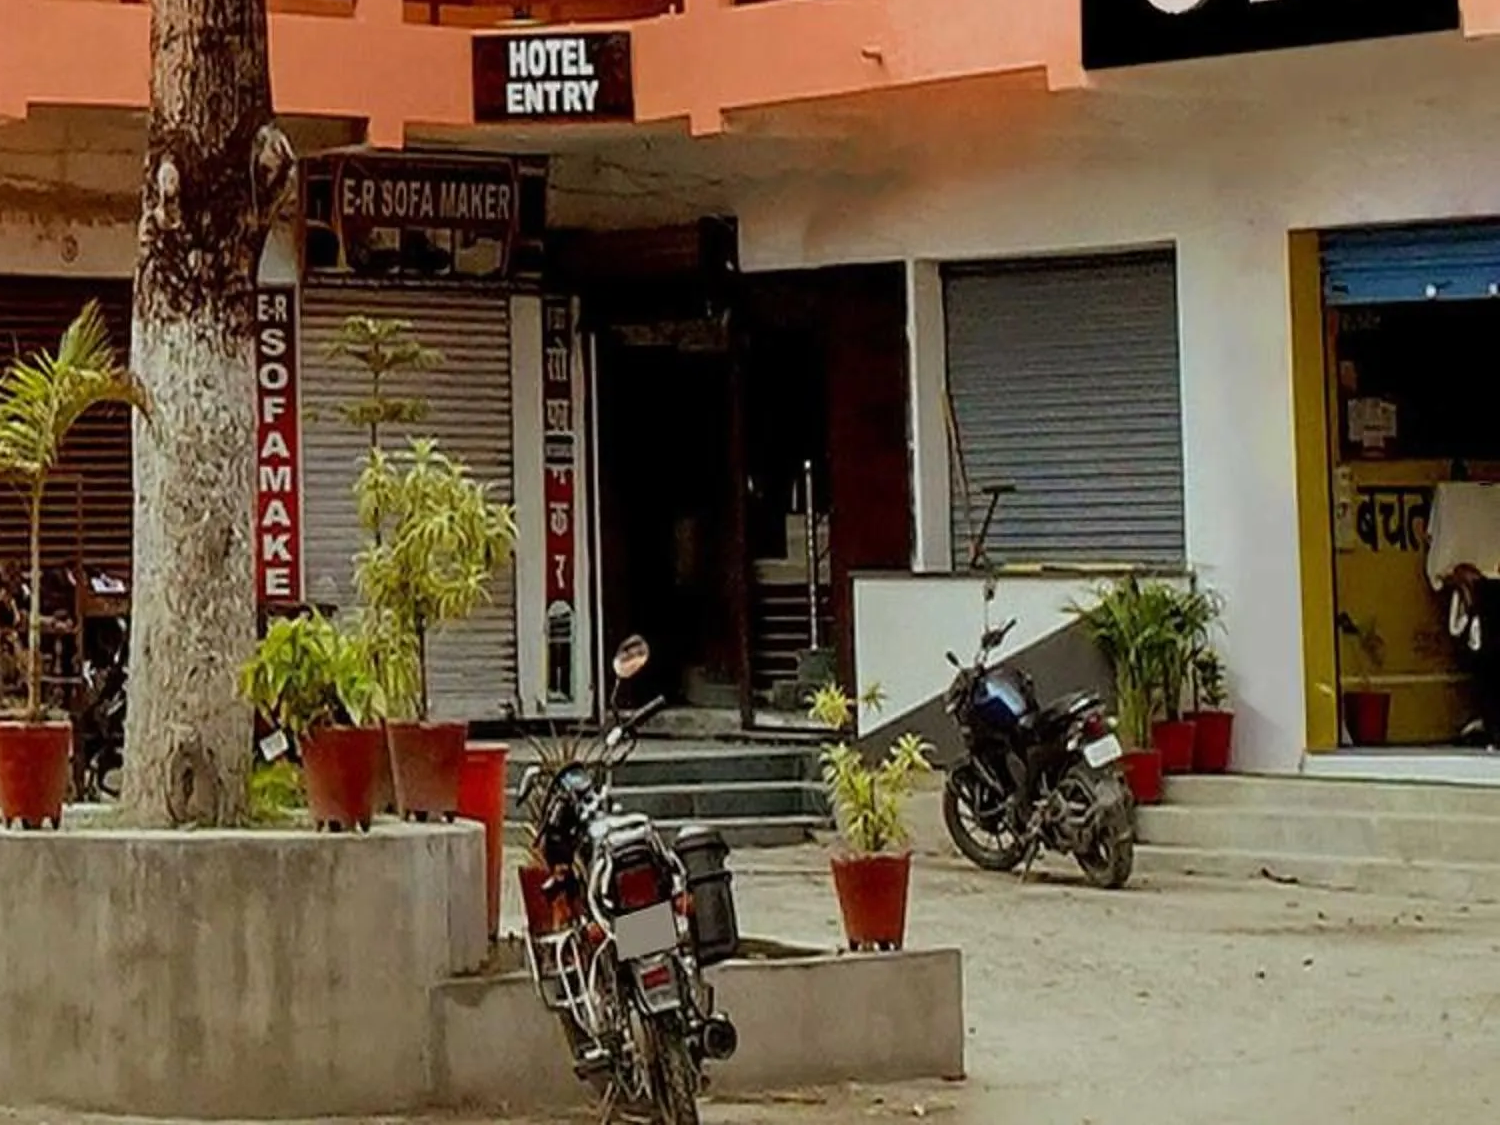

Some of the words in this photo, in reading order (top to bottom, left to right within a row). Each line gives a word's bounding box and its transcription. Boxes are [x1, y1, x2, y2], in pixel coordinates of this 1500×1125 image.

[508, 38, 594, 78] HOTEL
[506, 80, 599, 114] ENTRY
[342, 177, 376, 217] E-R
[380, 179, 434, 219] SOFA
[439, 181, 511, 221] MAKER
[255, 293, 288, 322] E-R
